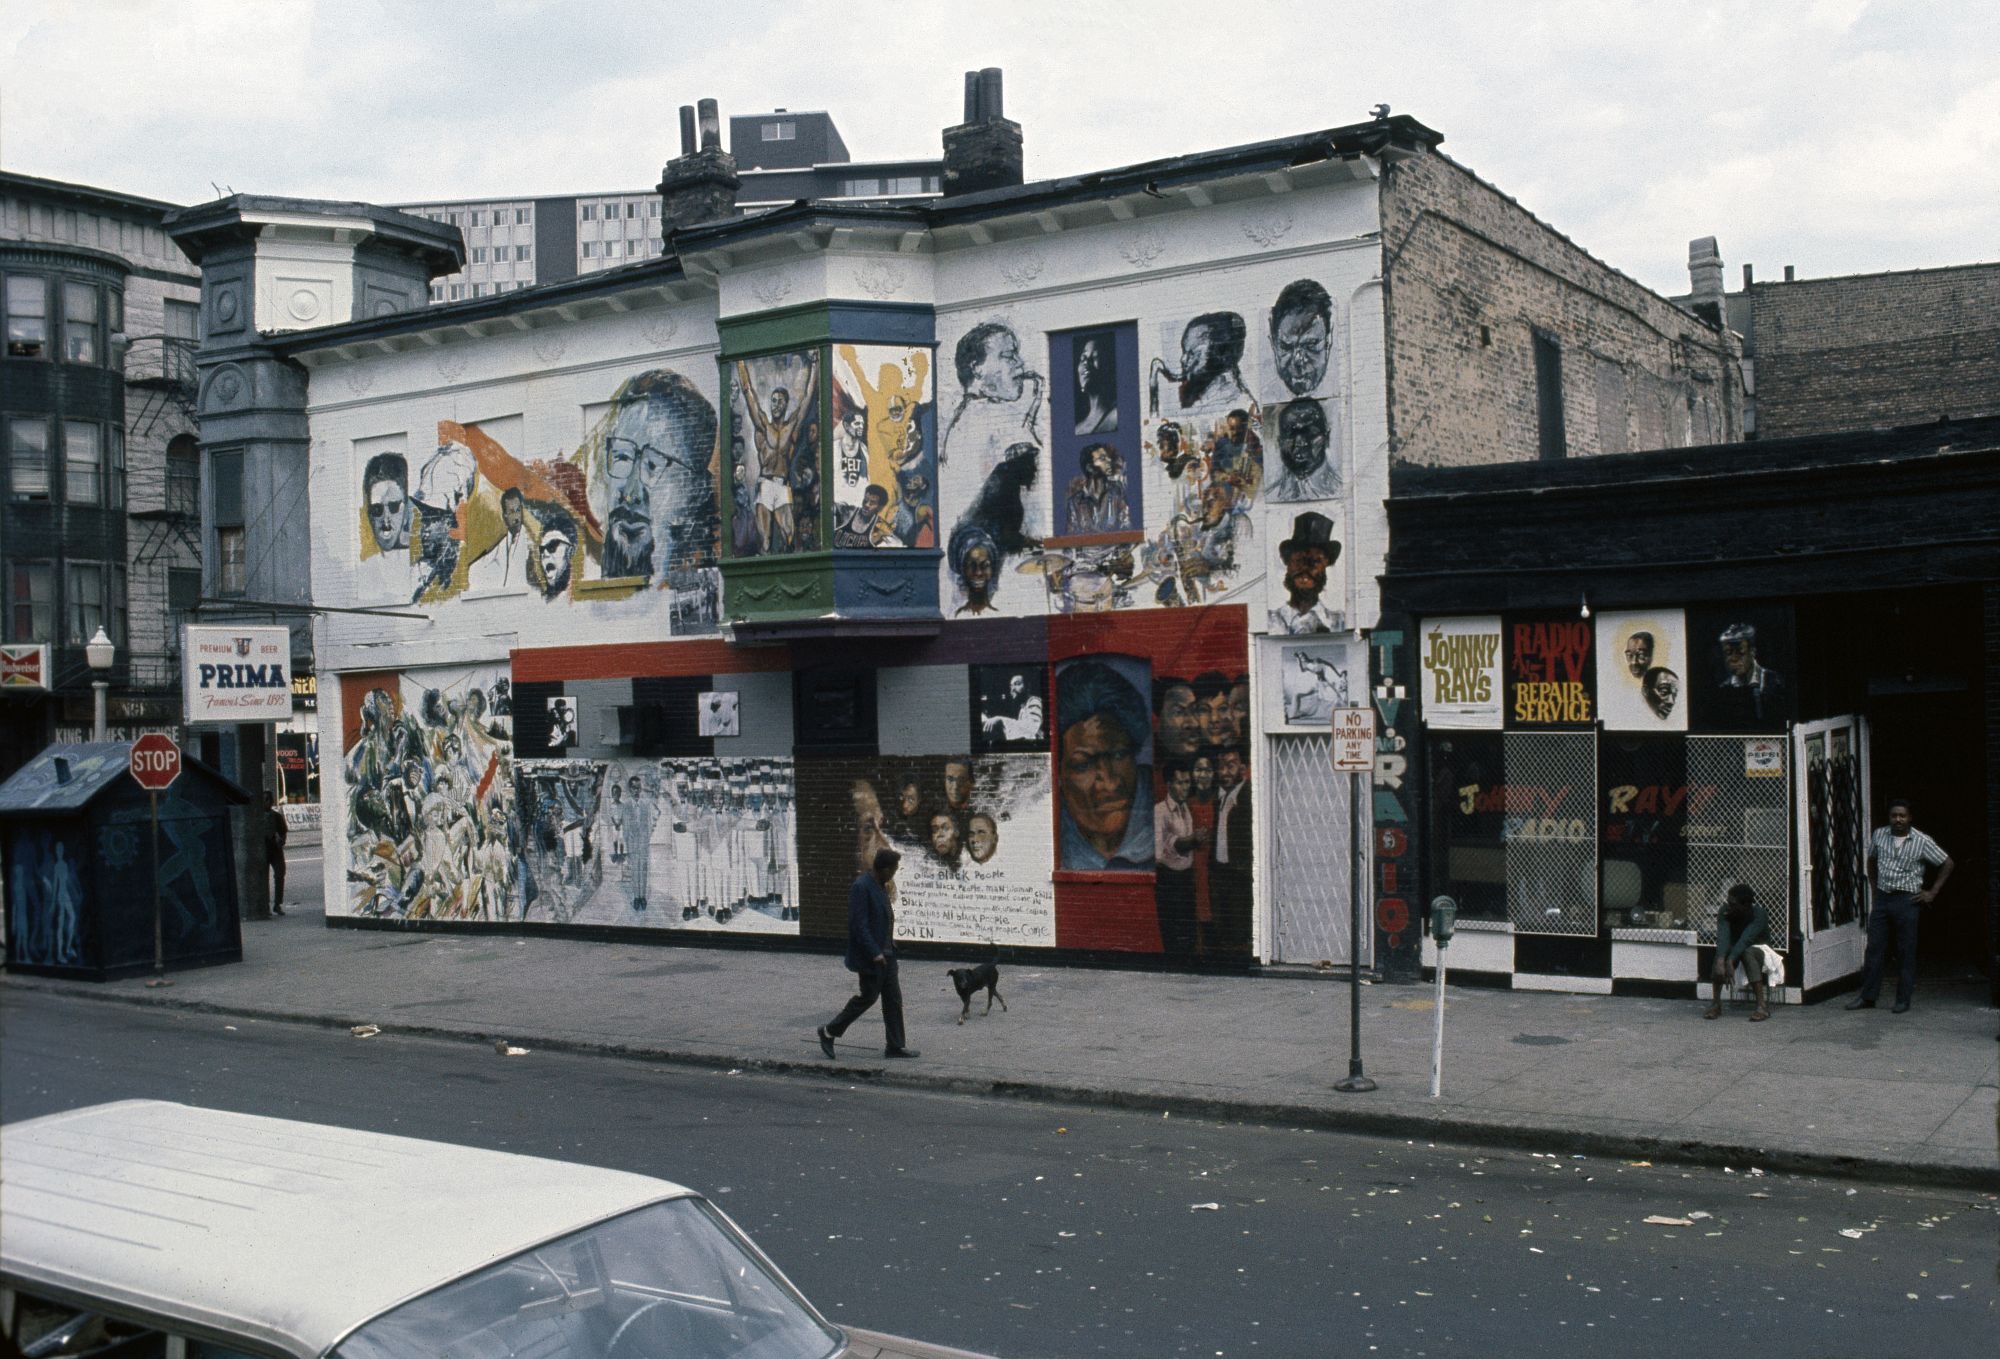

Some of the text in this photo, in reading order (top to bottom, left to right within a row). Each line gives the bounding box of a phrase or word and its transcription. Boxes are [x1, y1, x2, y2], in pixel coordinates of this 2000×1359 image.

[848, 473, 858, 487] 6
[200, 644, 278, 653] PREMIUM BEER
[1514, 622, 1590, 660] RADIO
[1424, 632, 1499, 669] JOHNNY
[199, 664, 286, 688] PRIMA
[1516, 682, 1584, 704] REPAIR
[1515, 700, 1591, 722] SERVICE
[1346, 714, 1361, 726] NO
[55, 727, 81, 744] KING
[87, 727, 125, 743] JMES
[1336, 728, 1372, 740] PARKING
[1347, 741, 1361, 750] ANY
[134, 750, 176, 772] STOP
[1346, 751, 1361, 759] TIME
[897, 925, 915, 938] ON
